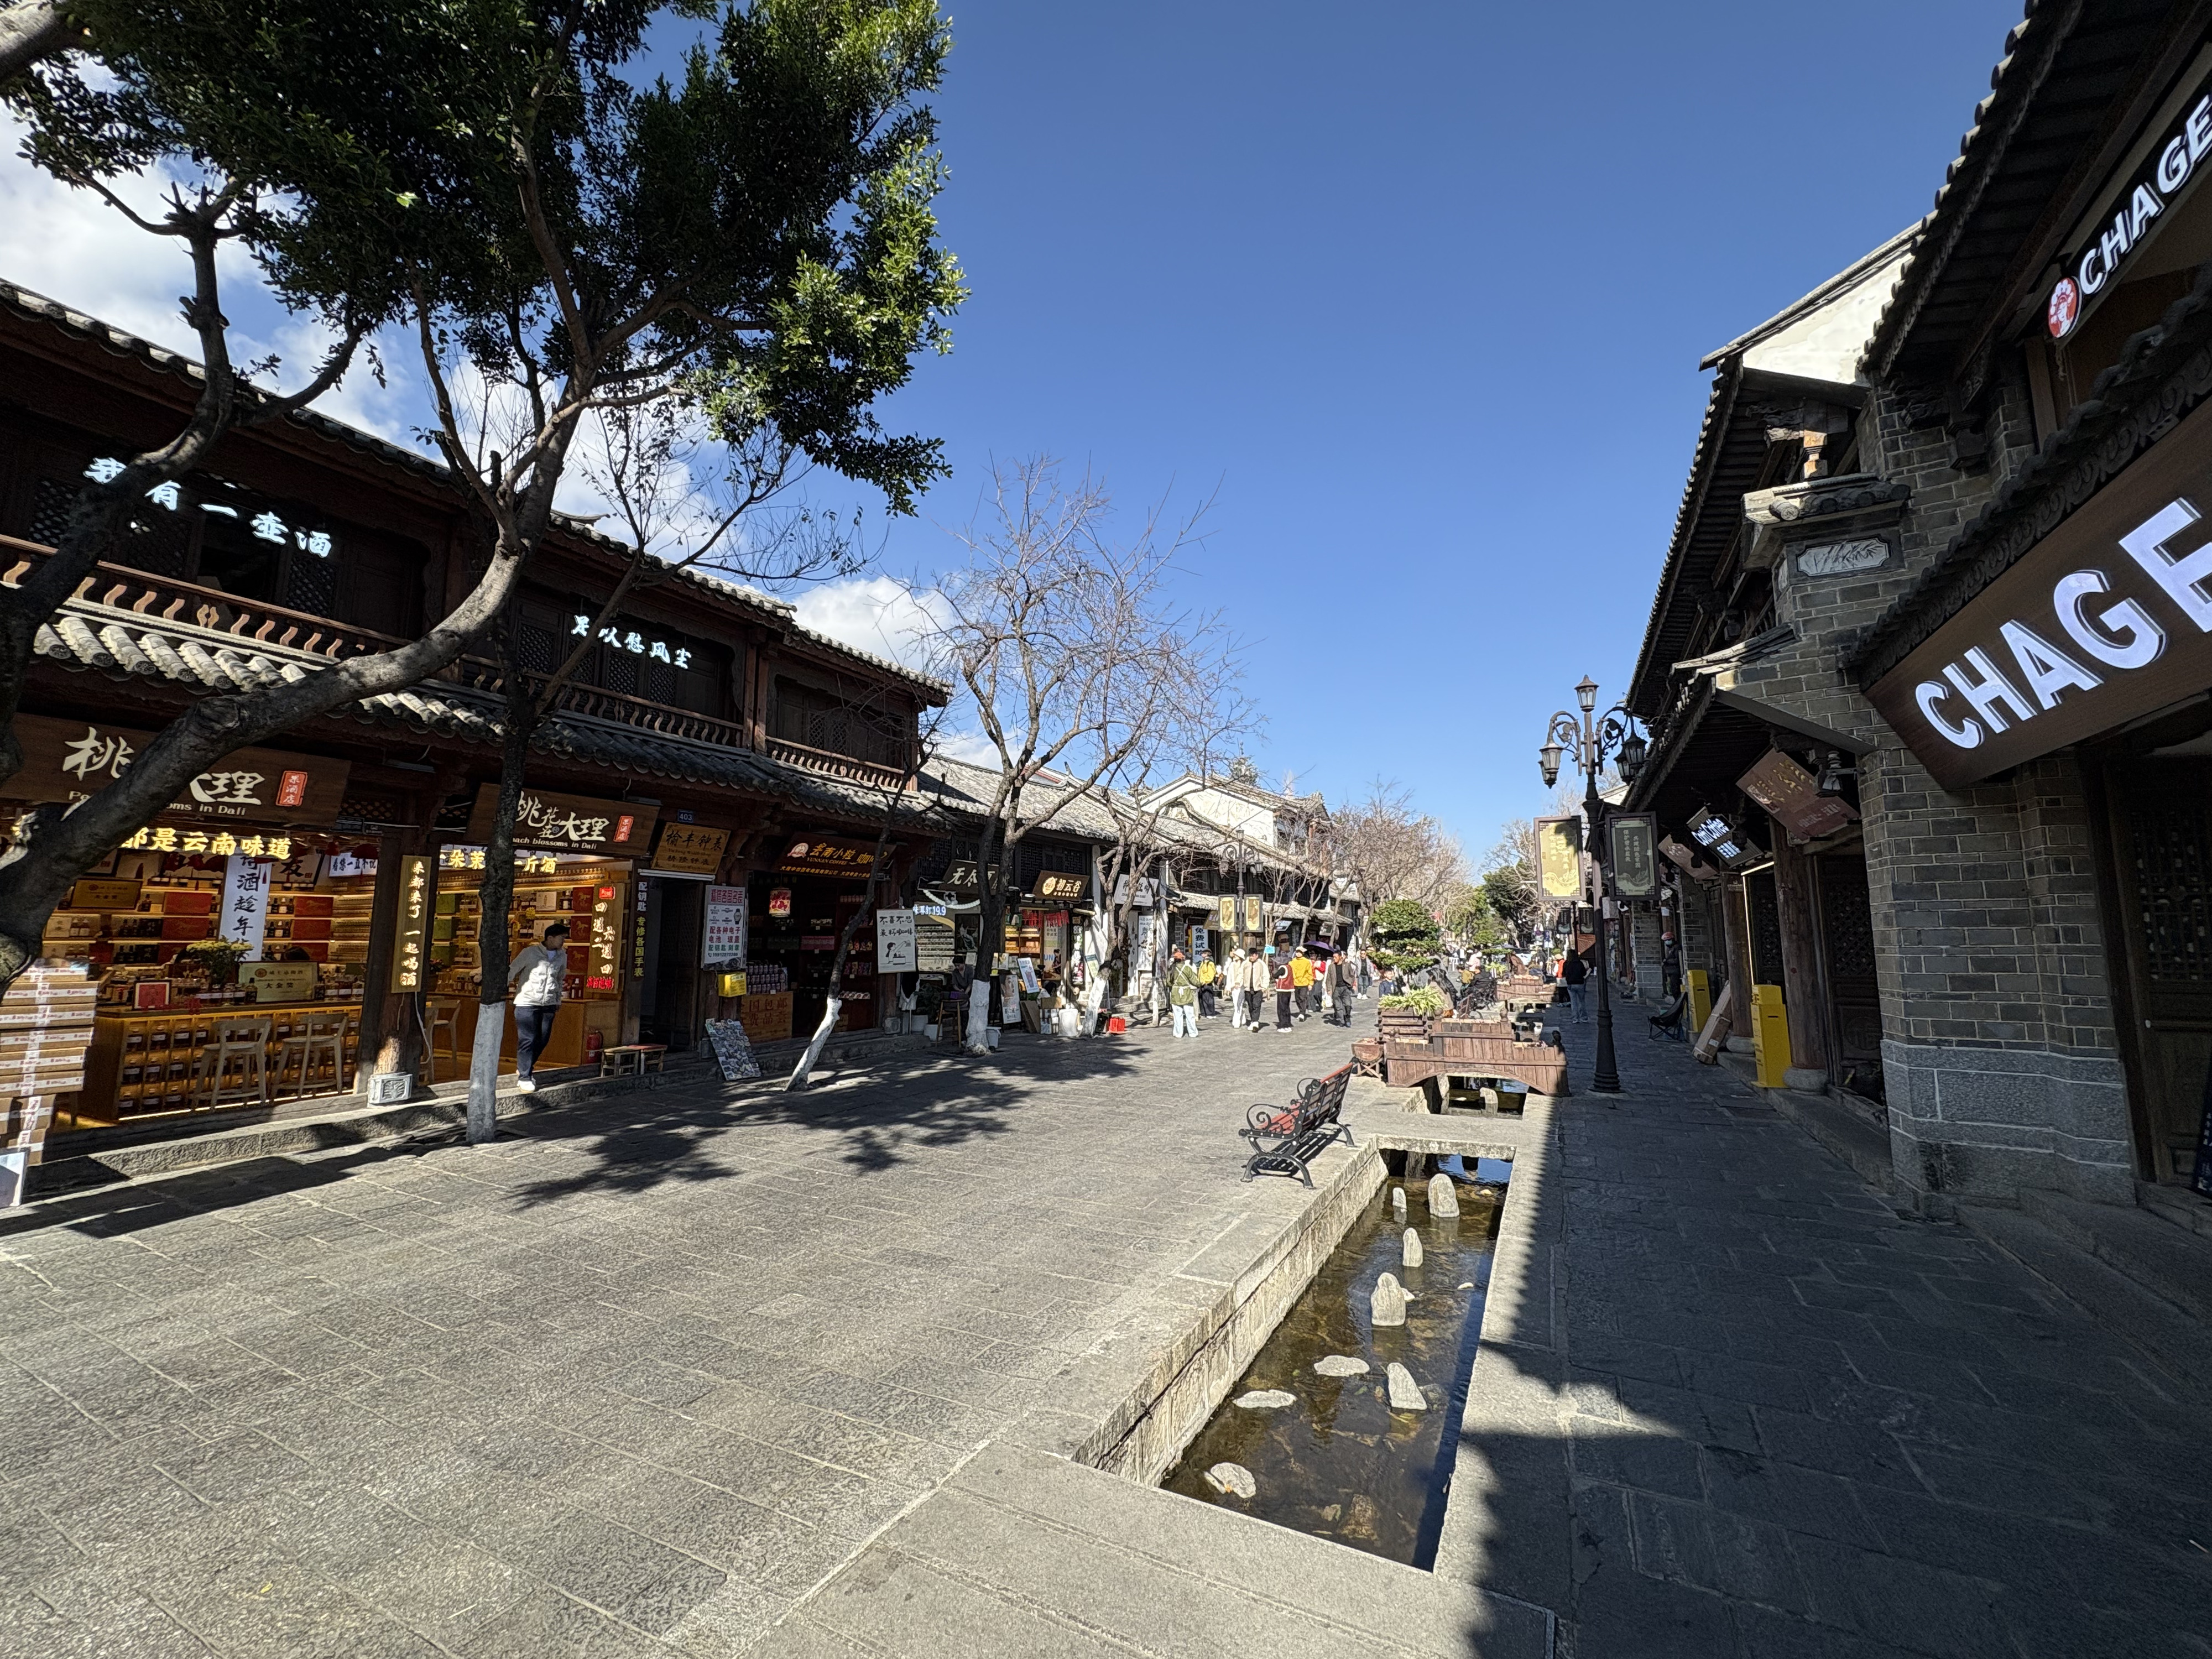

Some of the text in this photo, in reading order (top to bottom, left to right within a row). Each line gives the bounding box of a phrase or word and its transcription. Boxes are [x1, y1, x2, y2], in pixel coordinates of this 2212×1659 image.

[571, 615, 691, 669] 足以慰风尘
[199, 804, 212, 813] in
[218, 804, 247, 816] Dali
[1700, 817, 1730, 839] Coffee
[532, 838, 568, 847] blossoms
[1056, 878, 1082, 893] 初云谷
[634, 881, 648, 978] 配钥匙 专修各国手表
[400, 930, 420, 987] 一起喝酒
